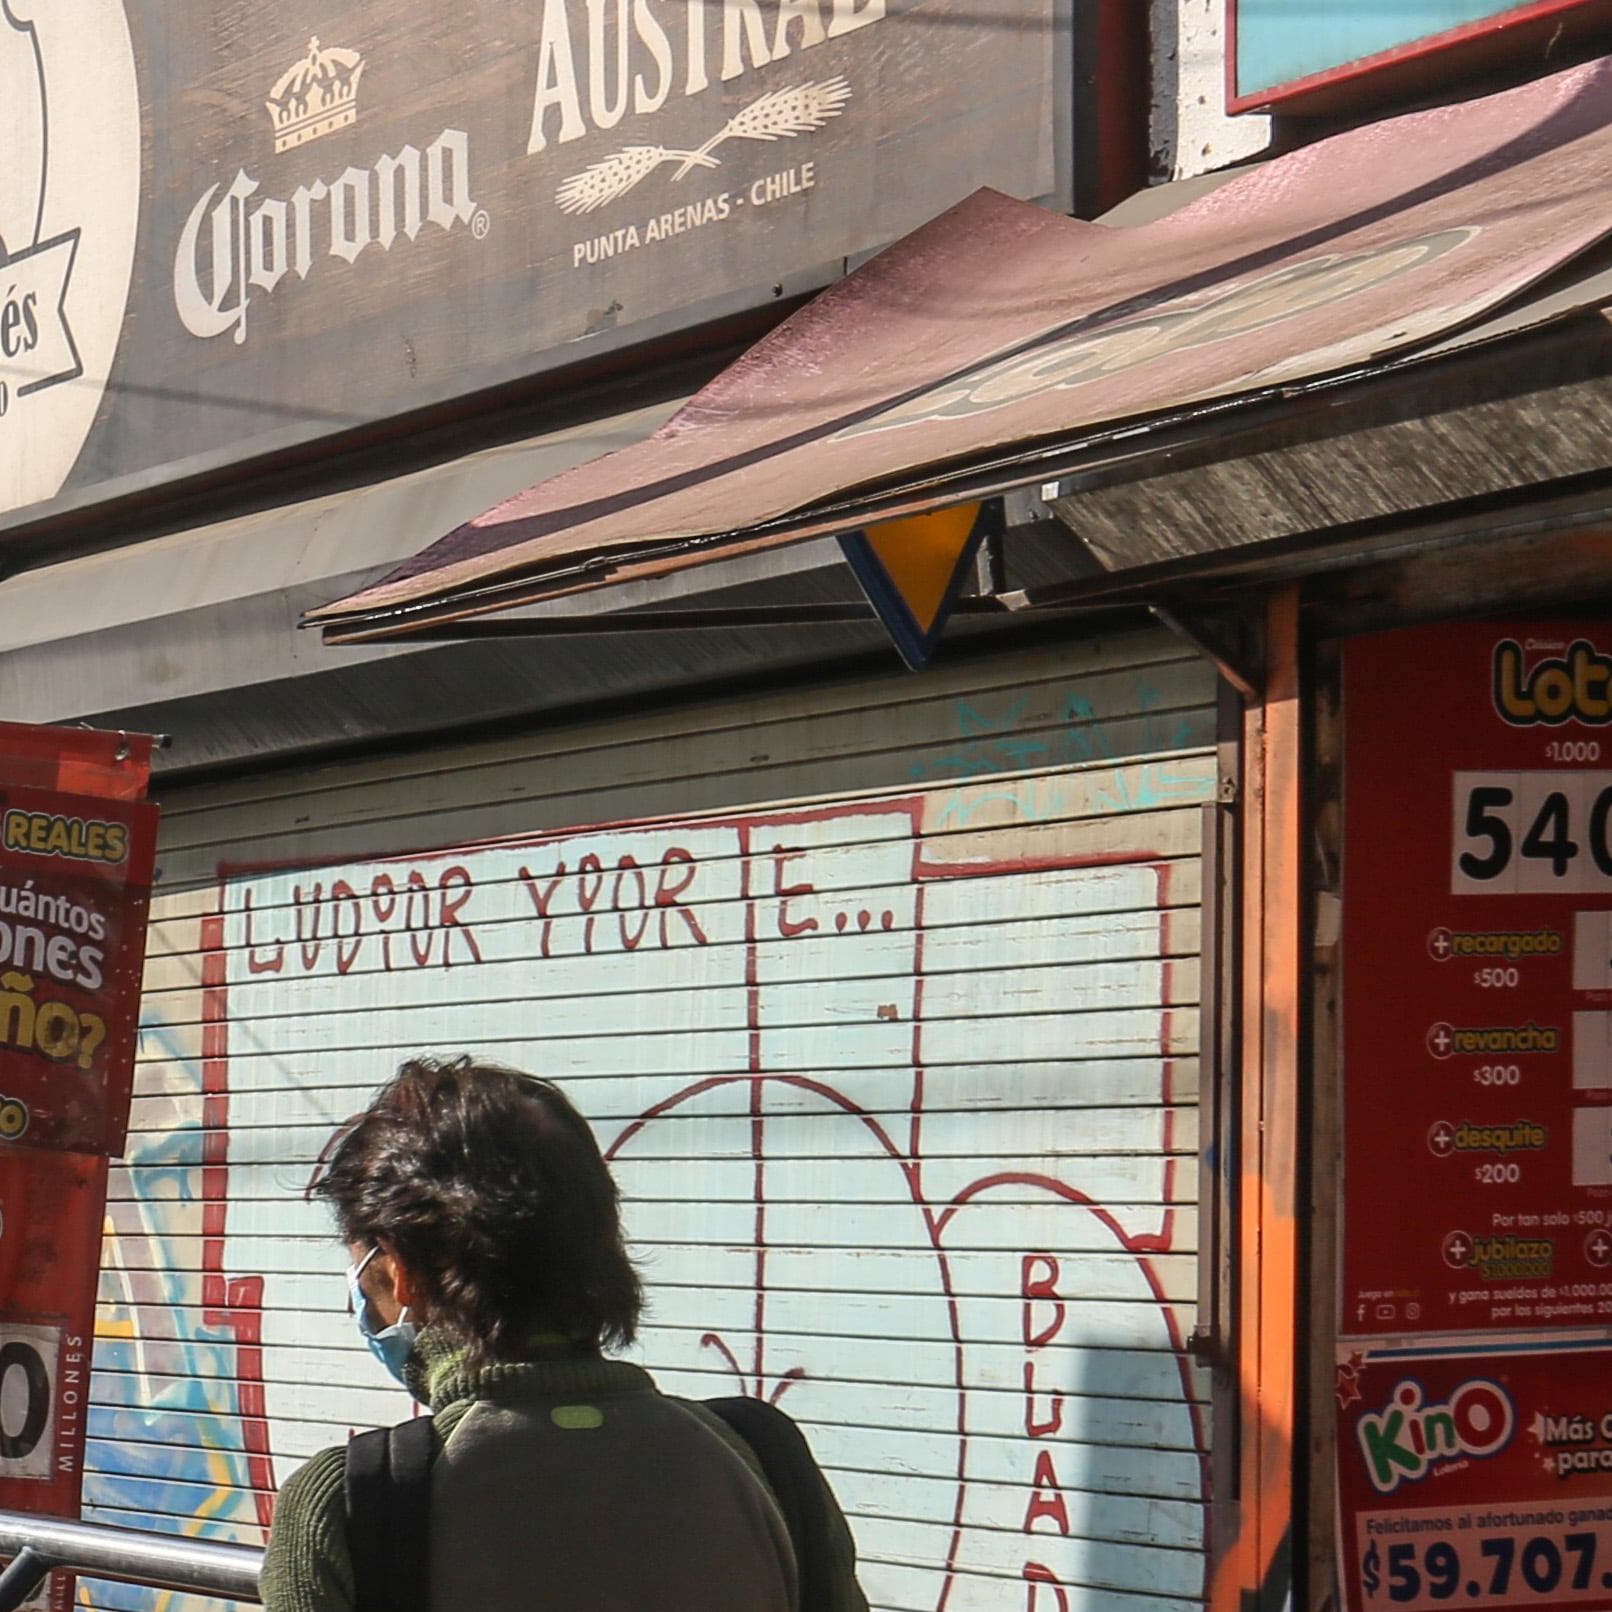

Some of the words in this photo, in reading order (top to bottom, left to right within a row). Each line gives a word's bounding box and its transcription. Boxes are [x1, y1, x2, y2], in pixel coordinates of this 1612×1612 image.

[572, 226, 641, 269] PUNTA
[644, 200, 730, 242] ARENAS
[749, 161, 816, 207] CHILE
[174, 128, 478, 345] Corona
[1501, 648, 1612, 717] Lot
[7, 813, 127, 861] REALES
[1455, 929, 1561, 958] recargado
[1473, 967, 1519, 988] $500
[1455, 1022, 1557, 1050] revancha
[1473, 1065, 1521, 1085] $300
[1456, 1121, 1545, 1154] desquite
[1474, 1163, 1521, 1183] $200
[1470, 1235, 1553, 1265] jubilazo
[58, 1333, 82, 1474] MILLONES
[1544, 1415, 1594, 1441] Más
[1366, 1515, 1453, 1535] Felicitamos
[1457, 1513, 1472, 1530] al
[1476, 1508, 1564, 1528] afortunado
[1362, 1531, 1612, 1603] $59.707.
